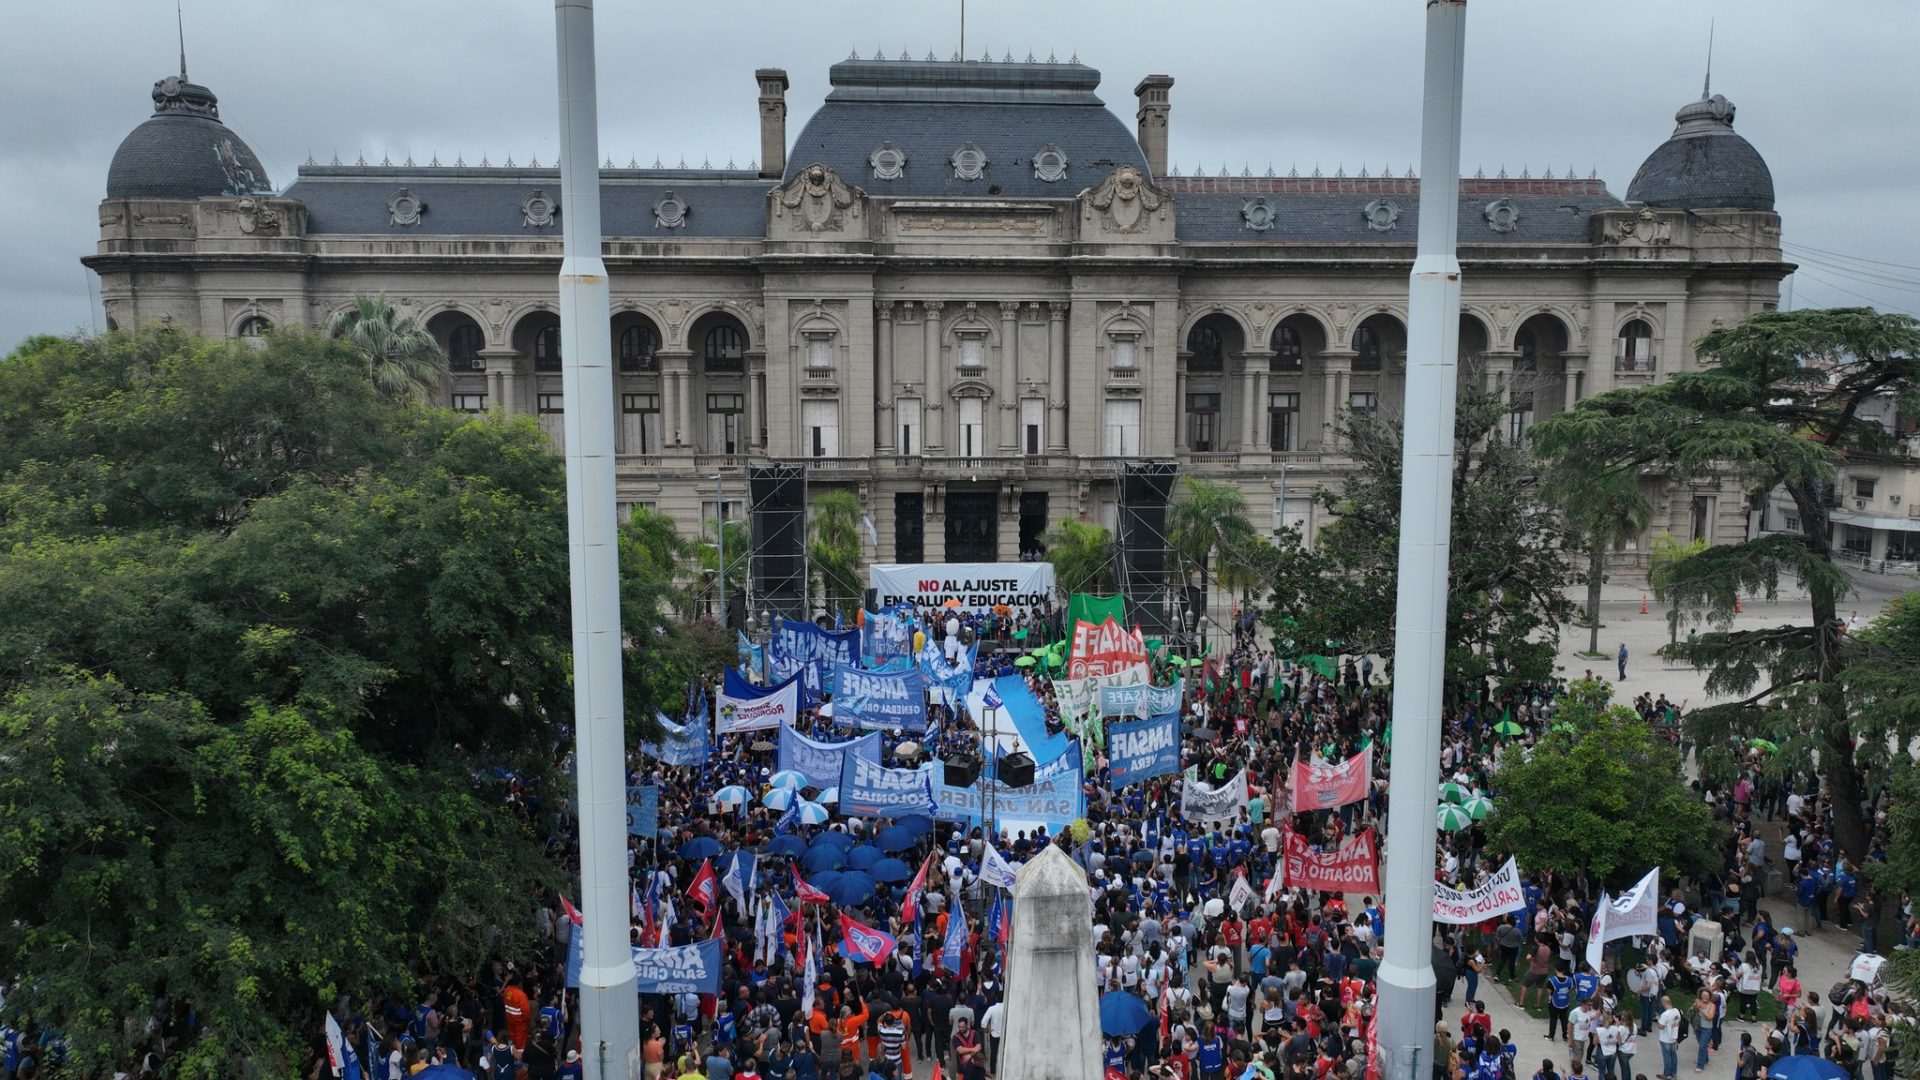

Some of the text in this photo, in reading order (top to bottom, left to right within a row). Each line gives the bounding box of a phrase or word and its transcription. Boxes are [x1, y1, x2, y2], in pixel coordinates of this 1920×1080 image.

[918, 579, 1018, 592] NO AL AJUSTE
[884, 595, 903, 608] EN
[969, 591, 1048, 607] EDUCACIÓN
